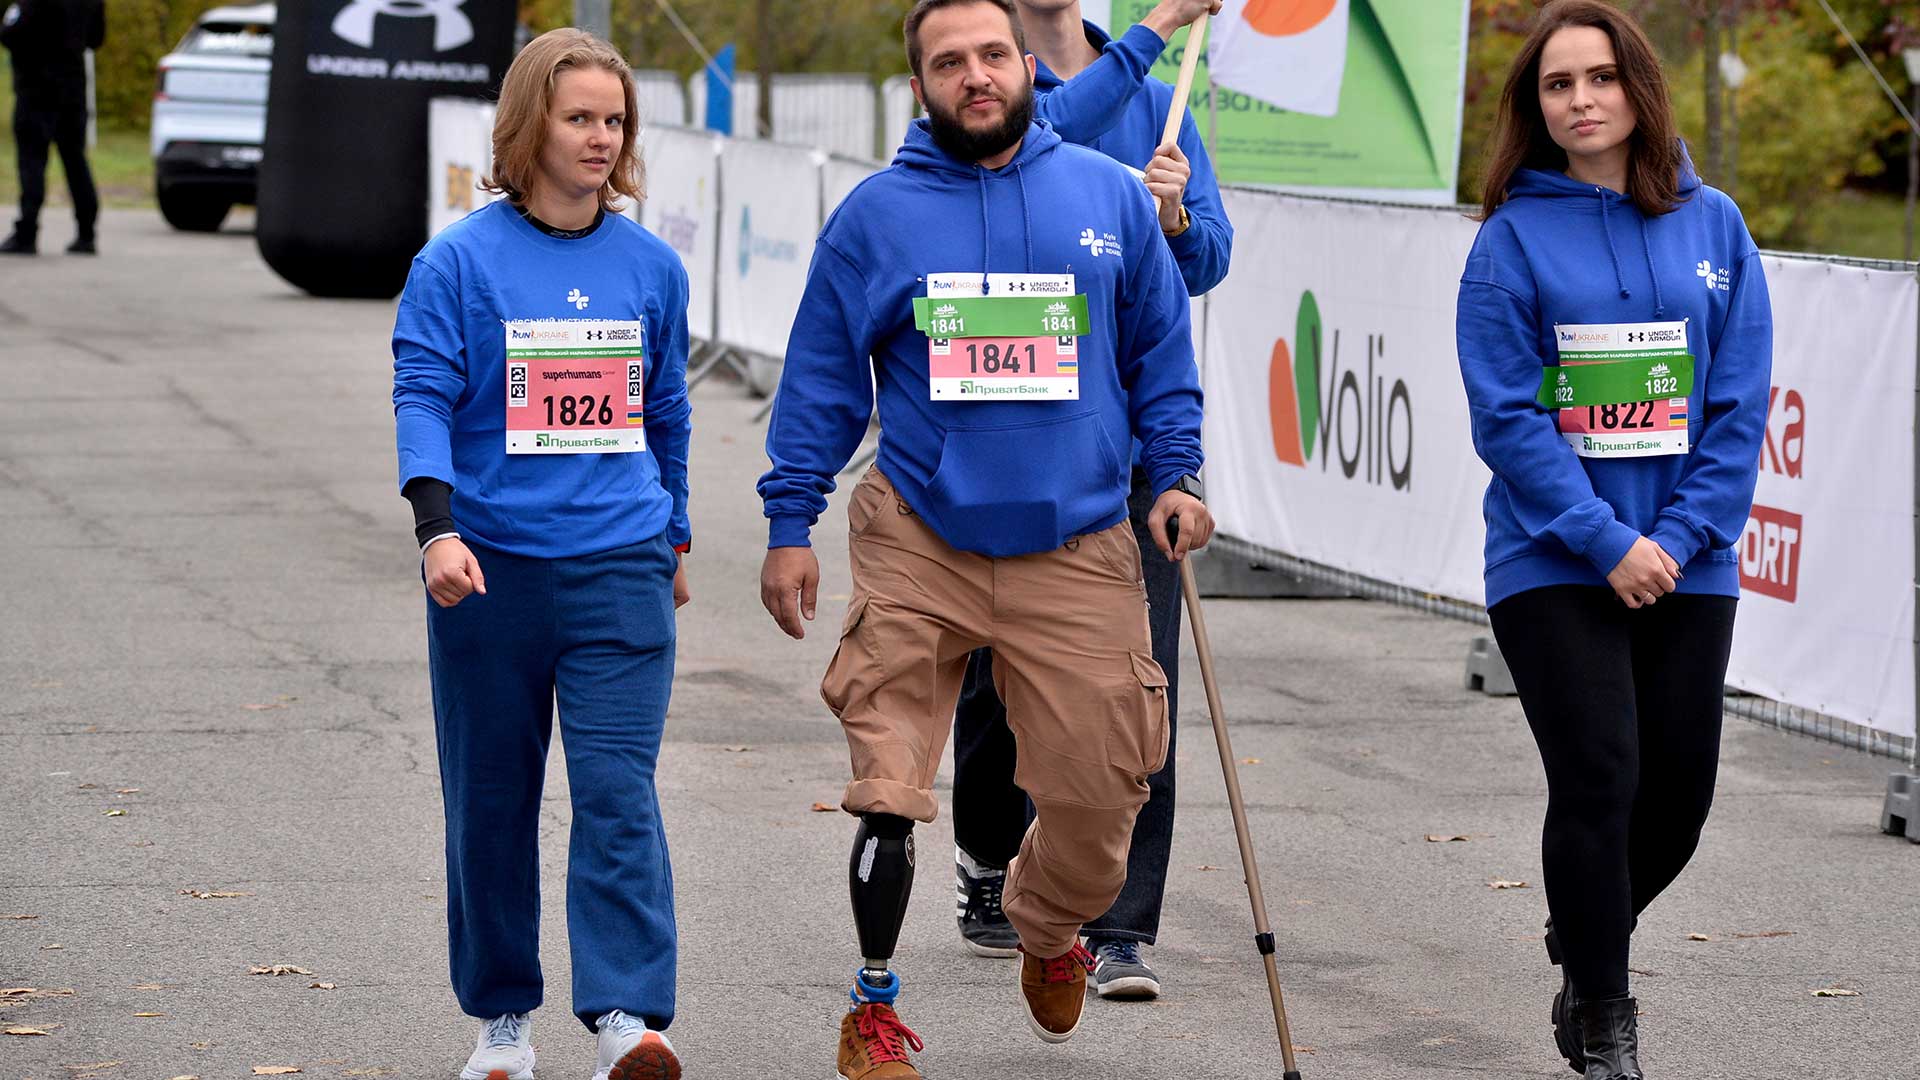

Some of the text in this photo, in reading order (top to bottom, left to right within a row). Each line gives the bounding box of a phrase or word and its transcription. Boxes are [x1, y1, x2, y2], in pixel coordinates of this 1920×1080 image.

[307, 54, 490, 83] UNDER ARMOUR
[931, 315, 1077, 334] 1841 1841
[966, 344, 1036, 374] 1841
[543, 370, 602, 381] superhumans
[1644, 377, 1677, 395] 1822
[974, 383, 1049, 395] ПриватБанк
[543, 395, 613, 426] 1826
[1311, 323, 1412, 493] Volia
[1585, 400, 1655, 430] 1822
[550, 437, 620, 449] ПриватБанк
[1593, 440, 1662, 452] ПриватБанк
[1740, 517, 1799, 586] ORT
